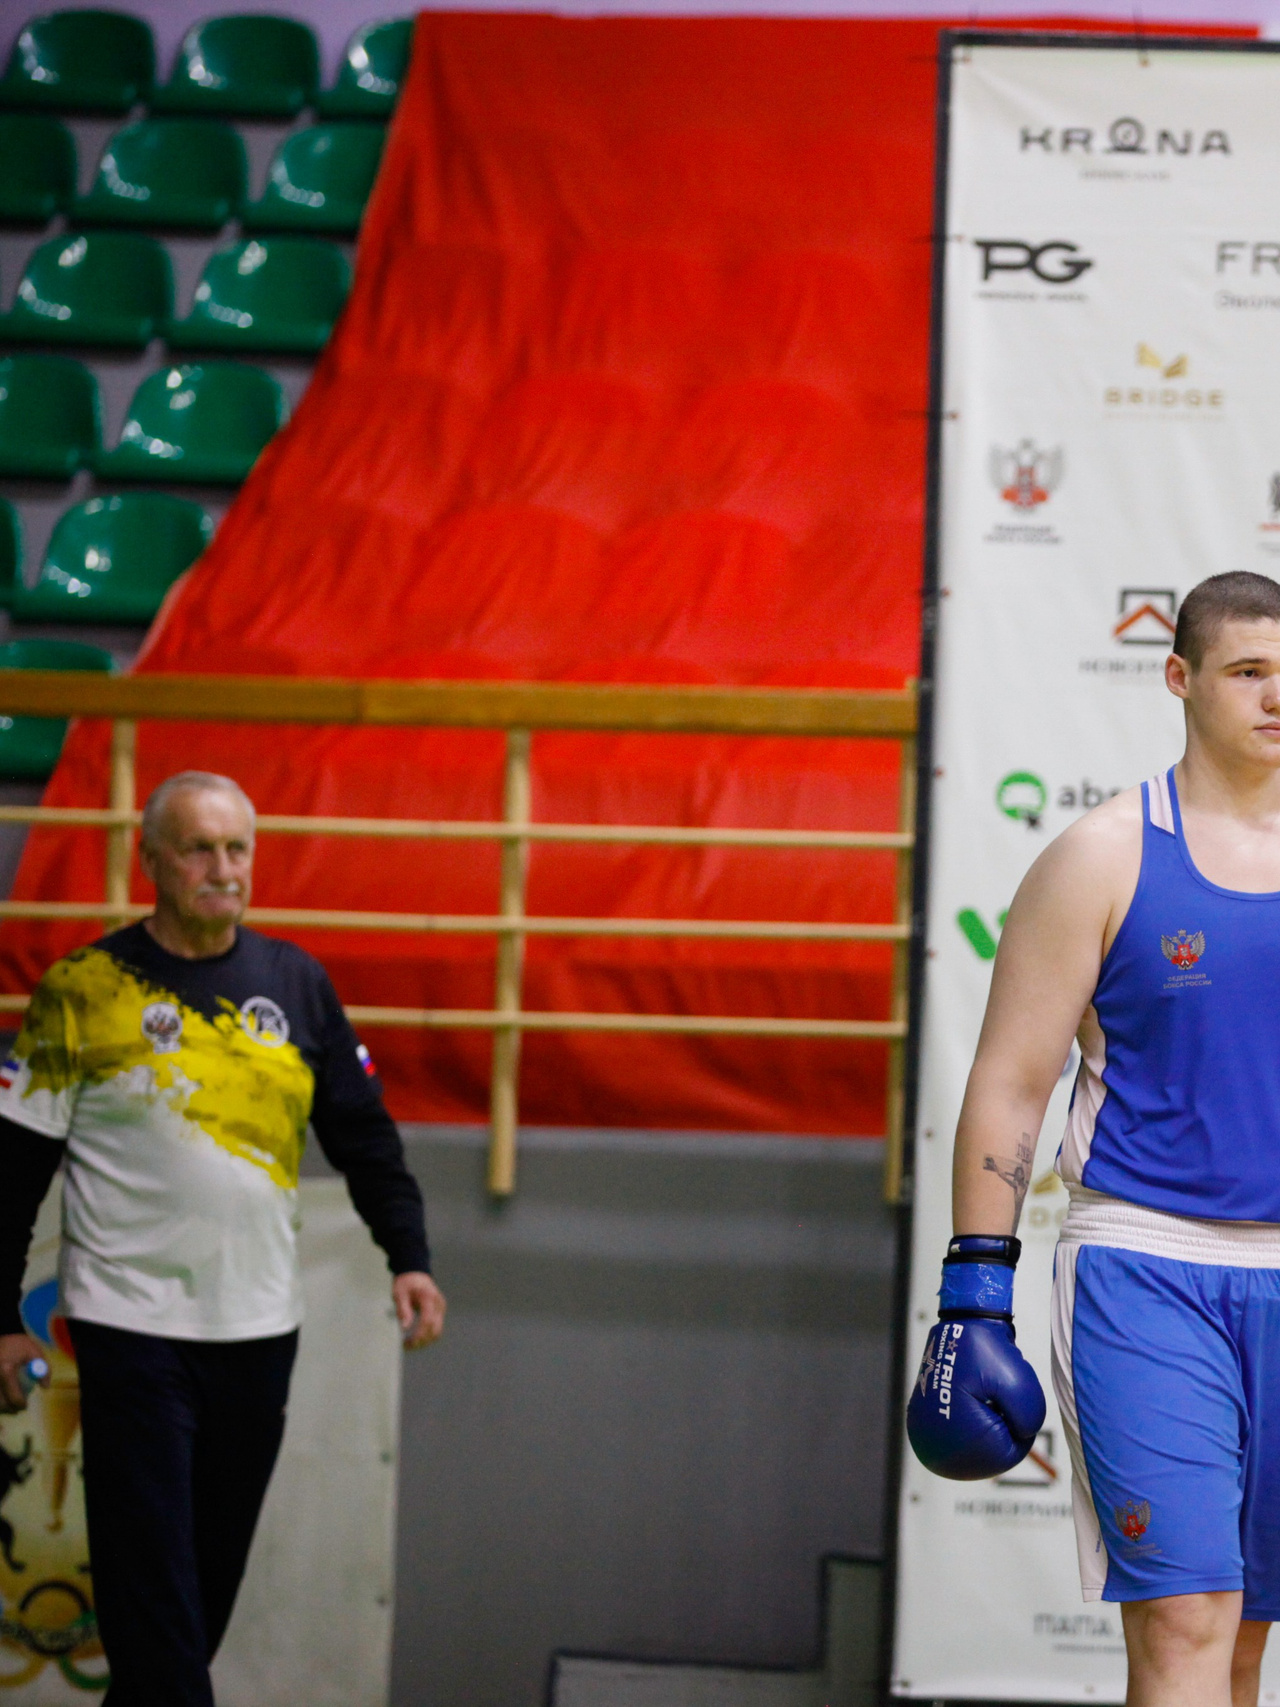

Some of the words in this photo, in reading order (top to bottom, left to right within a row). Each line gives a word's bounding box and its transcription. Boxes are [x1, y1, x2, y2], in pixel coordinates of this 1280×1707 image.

[974, 239, 1093, 284] PG
[1103, 385, 1226, 410] BRIDGE
[1168, 973, 1207, 982] ФЕДЕРАЦИЯ
[1186, 979, 1212, 987] РОССИИ
[937, 1324, 950, 1360] BOXING
[932, 1362, 942, 1390] TEAM
